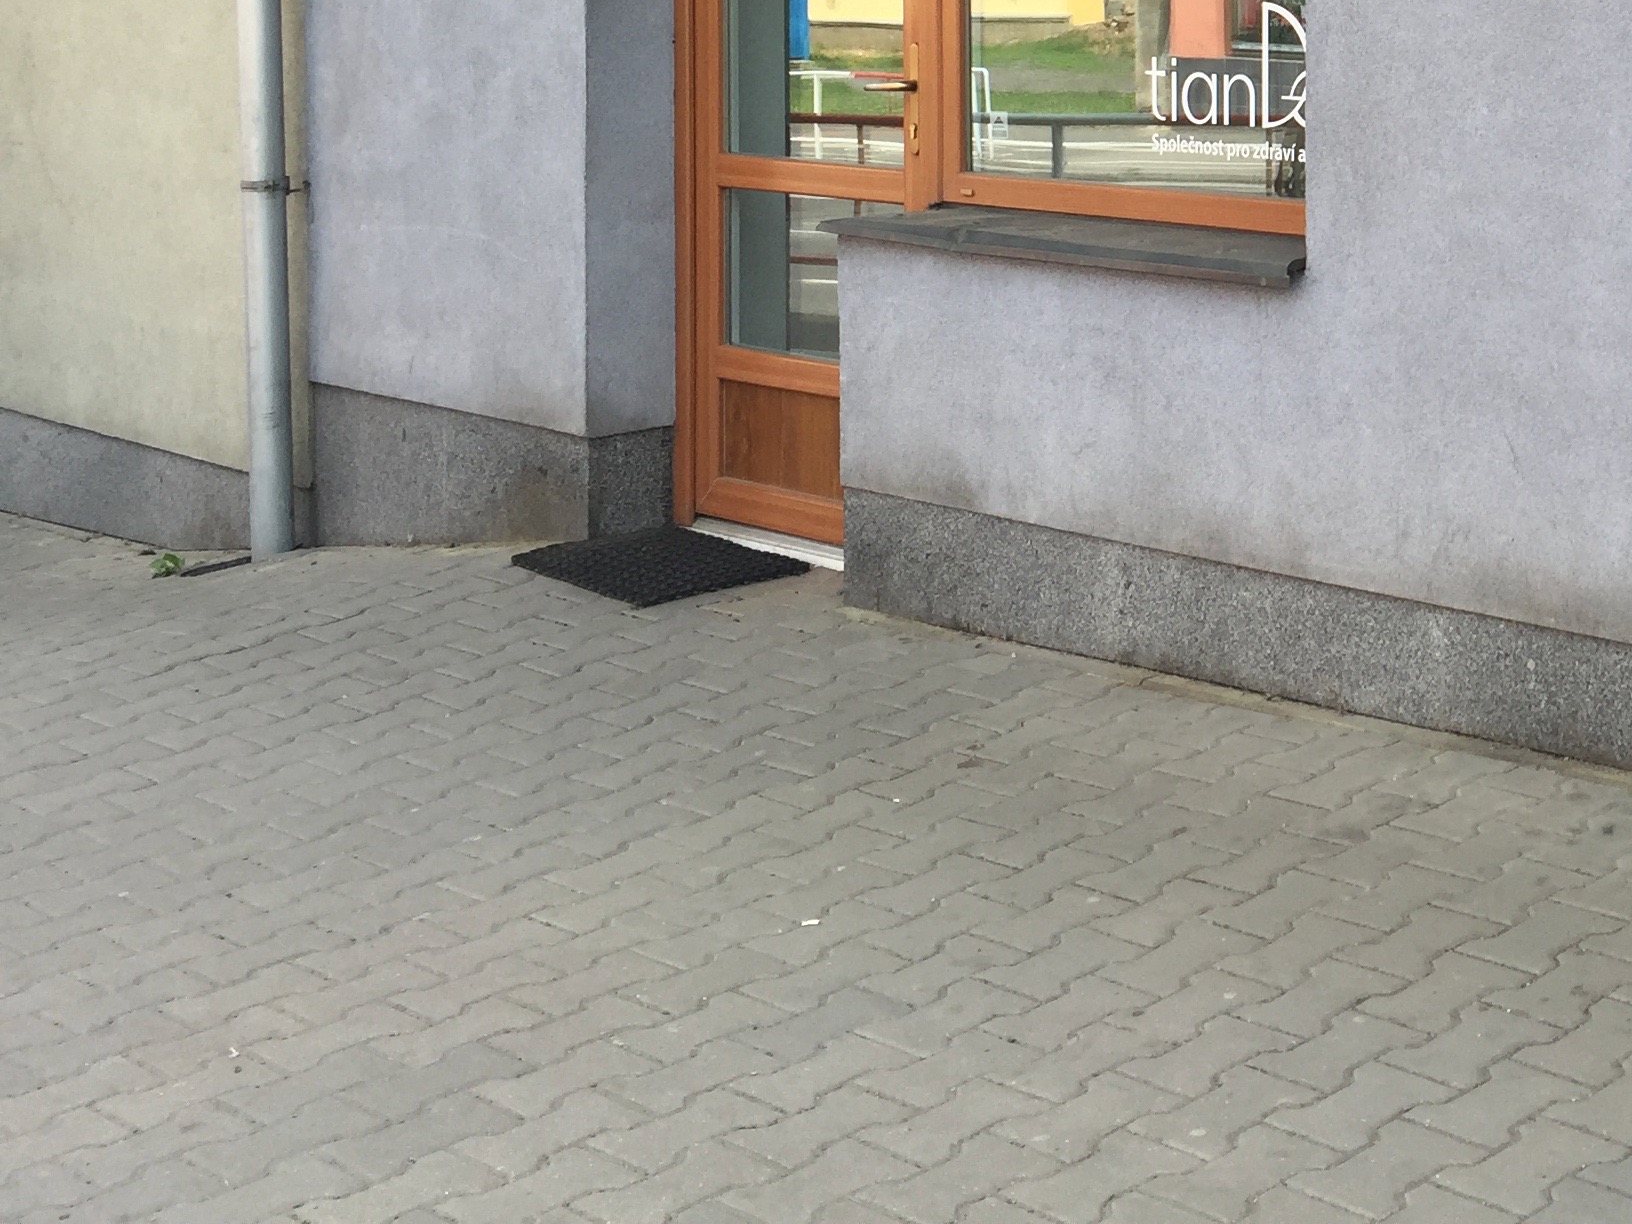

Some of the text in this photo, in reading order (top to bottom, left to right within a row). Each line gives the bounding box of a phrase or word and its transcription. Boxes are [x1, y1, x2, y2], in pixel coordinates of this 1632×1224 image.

[1151, 133, 1223, 156] Společnost
[1227, 144, 1250, 161] pro
[1253, 141, 1295, 161] zdraví
